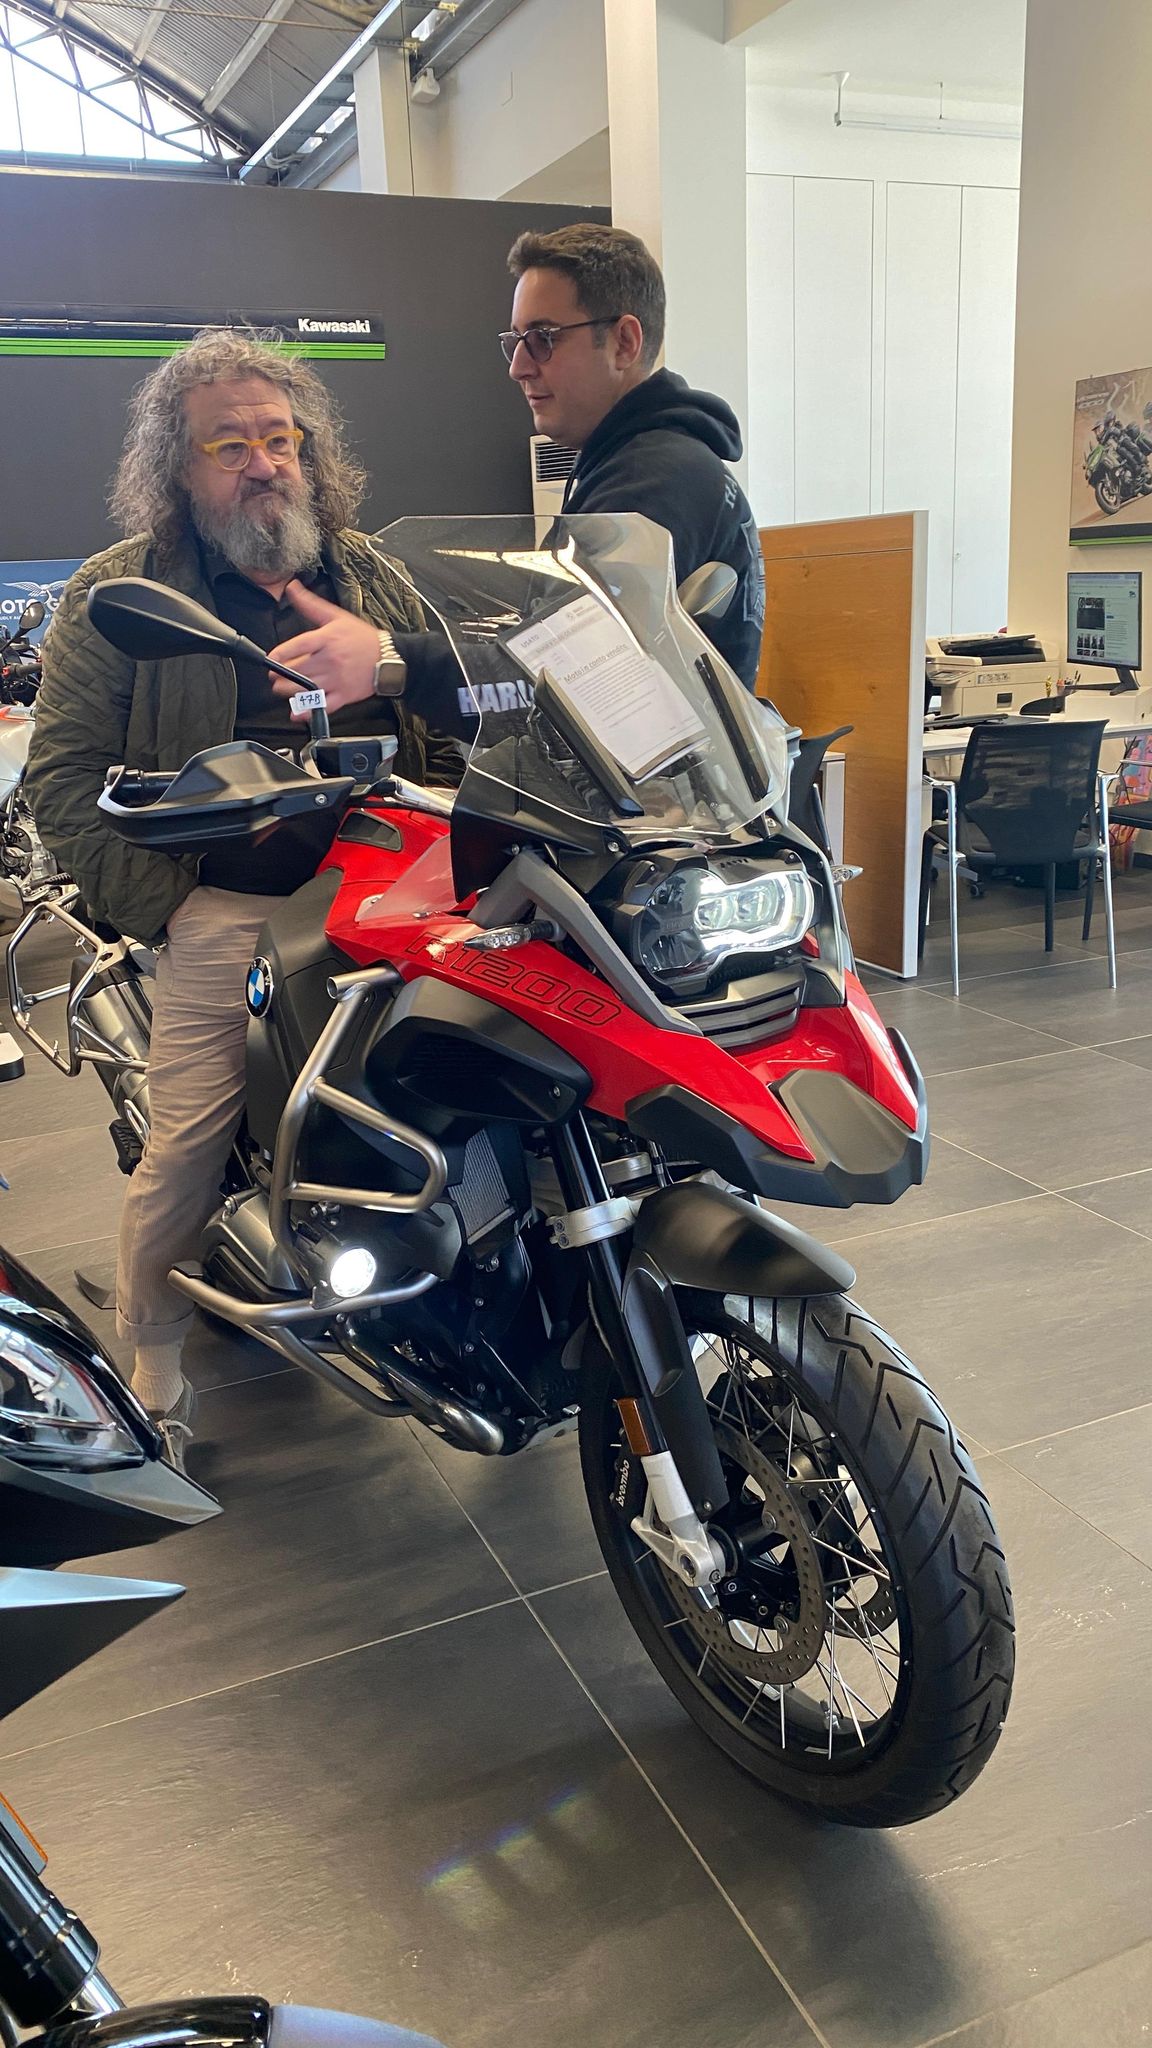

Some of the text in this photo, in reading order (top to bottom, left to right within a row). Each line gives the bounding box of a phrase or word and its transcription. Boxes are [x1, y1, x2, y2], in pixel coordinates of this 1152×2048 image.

[298, 318, 370, 333] Kawasaki
[457, 679, 536, 713] HARL
[615, 1459, 630, 1508] brembo
